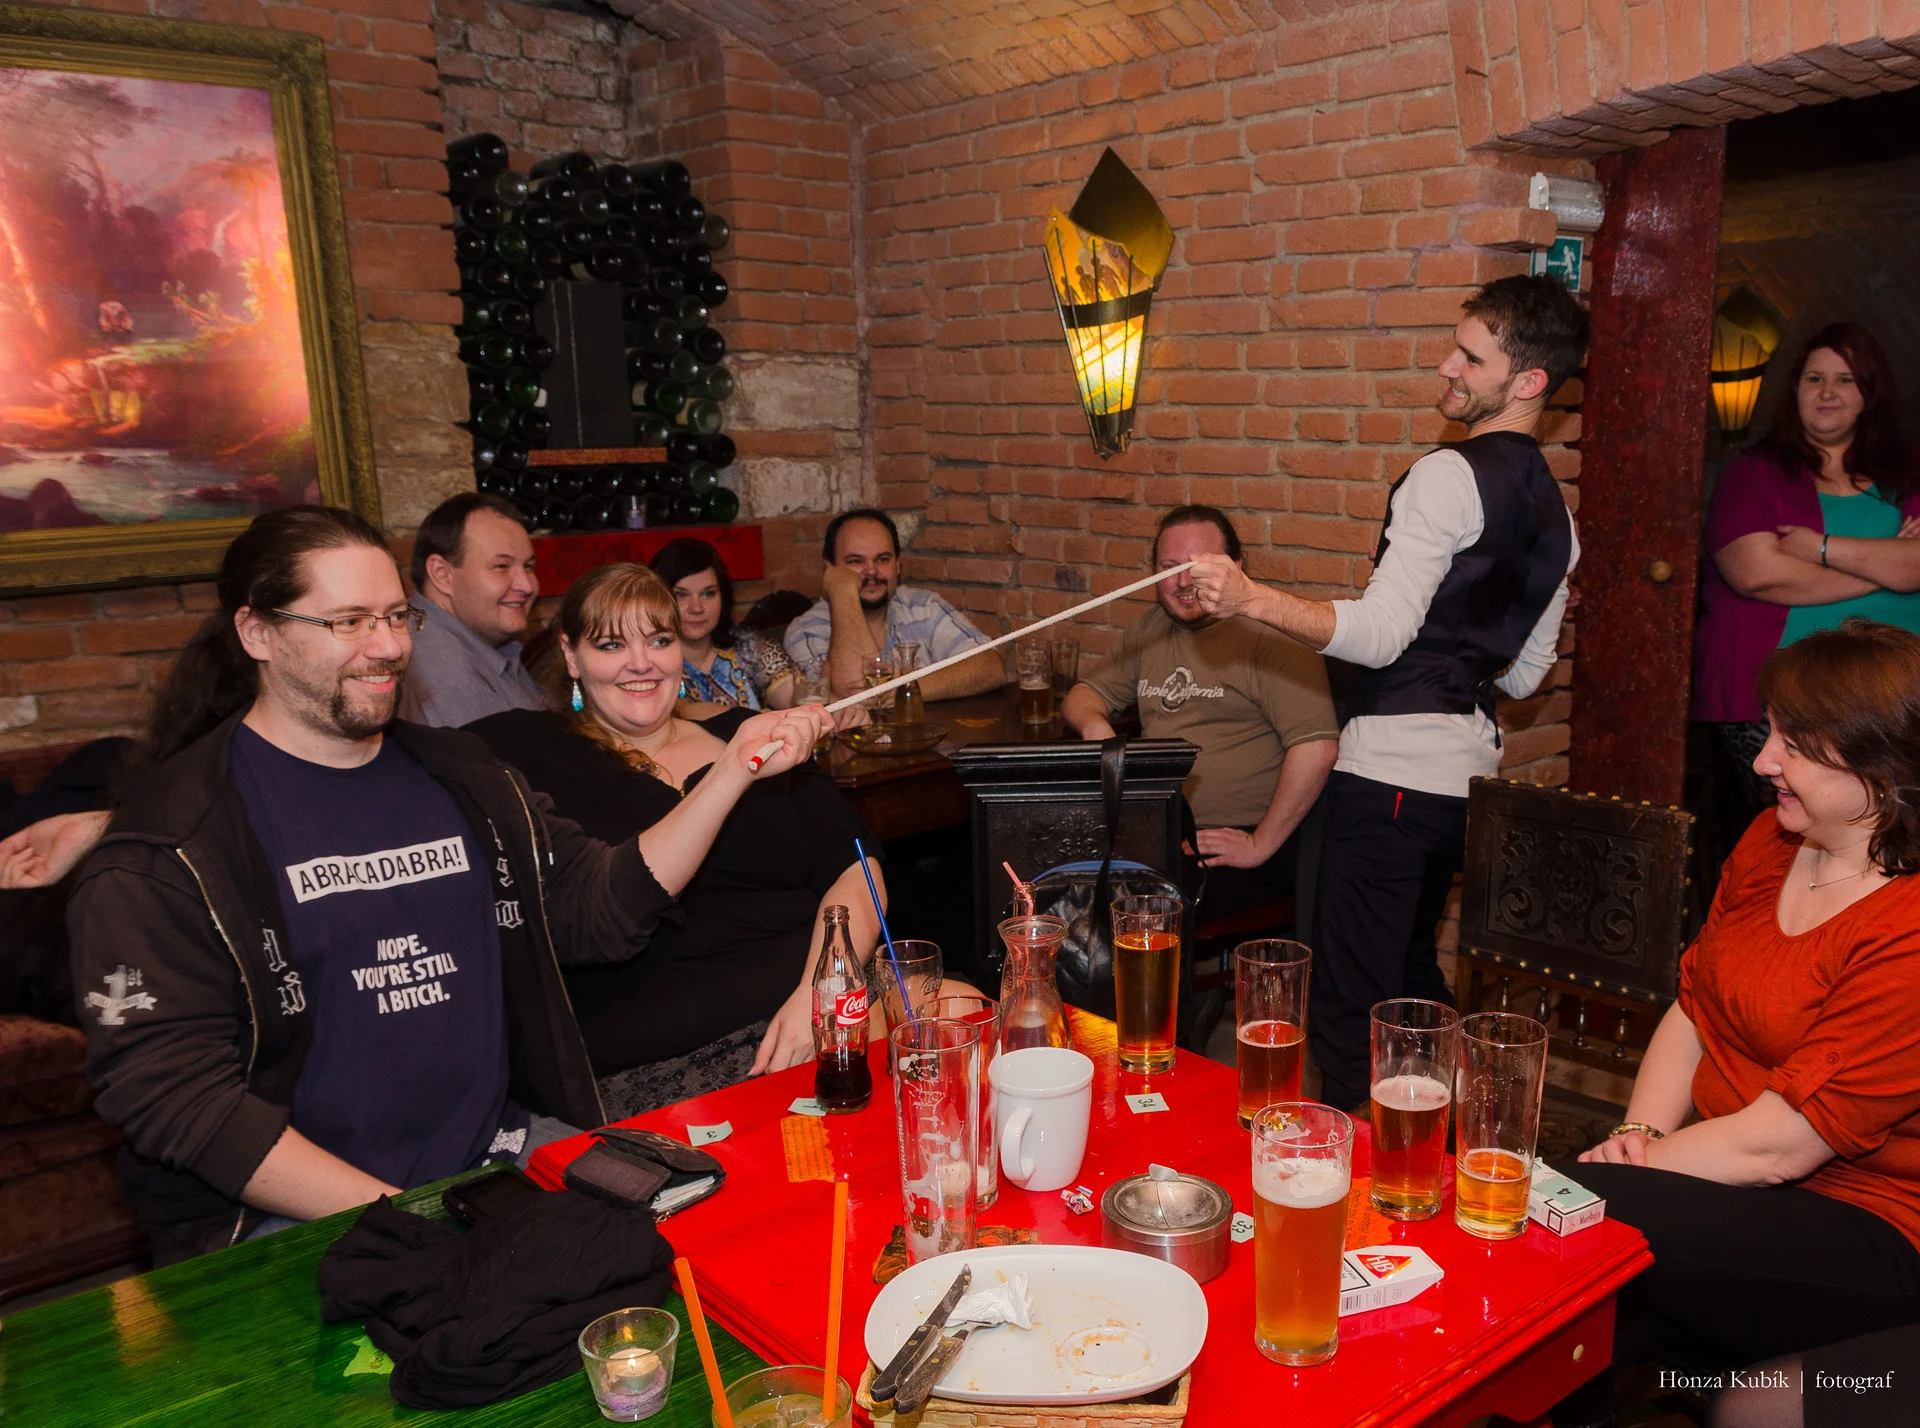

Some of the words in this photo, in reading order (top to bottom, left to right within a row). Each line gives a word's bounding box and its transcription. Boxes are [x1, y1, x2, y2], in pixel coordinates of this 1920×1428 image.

[300, 844, 462, 894] ABRACADABRA!
[377, 934, 428, 962] NOPE.
[351, 962, 413, 991] YOU'RE
[412, 953, 458, 981] STILL
[378, 993, 390, 1014] A
[388, 981, 451, 1012] BITCH.
[1366, 1255, 1396, 1273] HB
